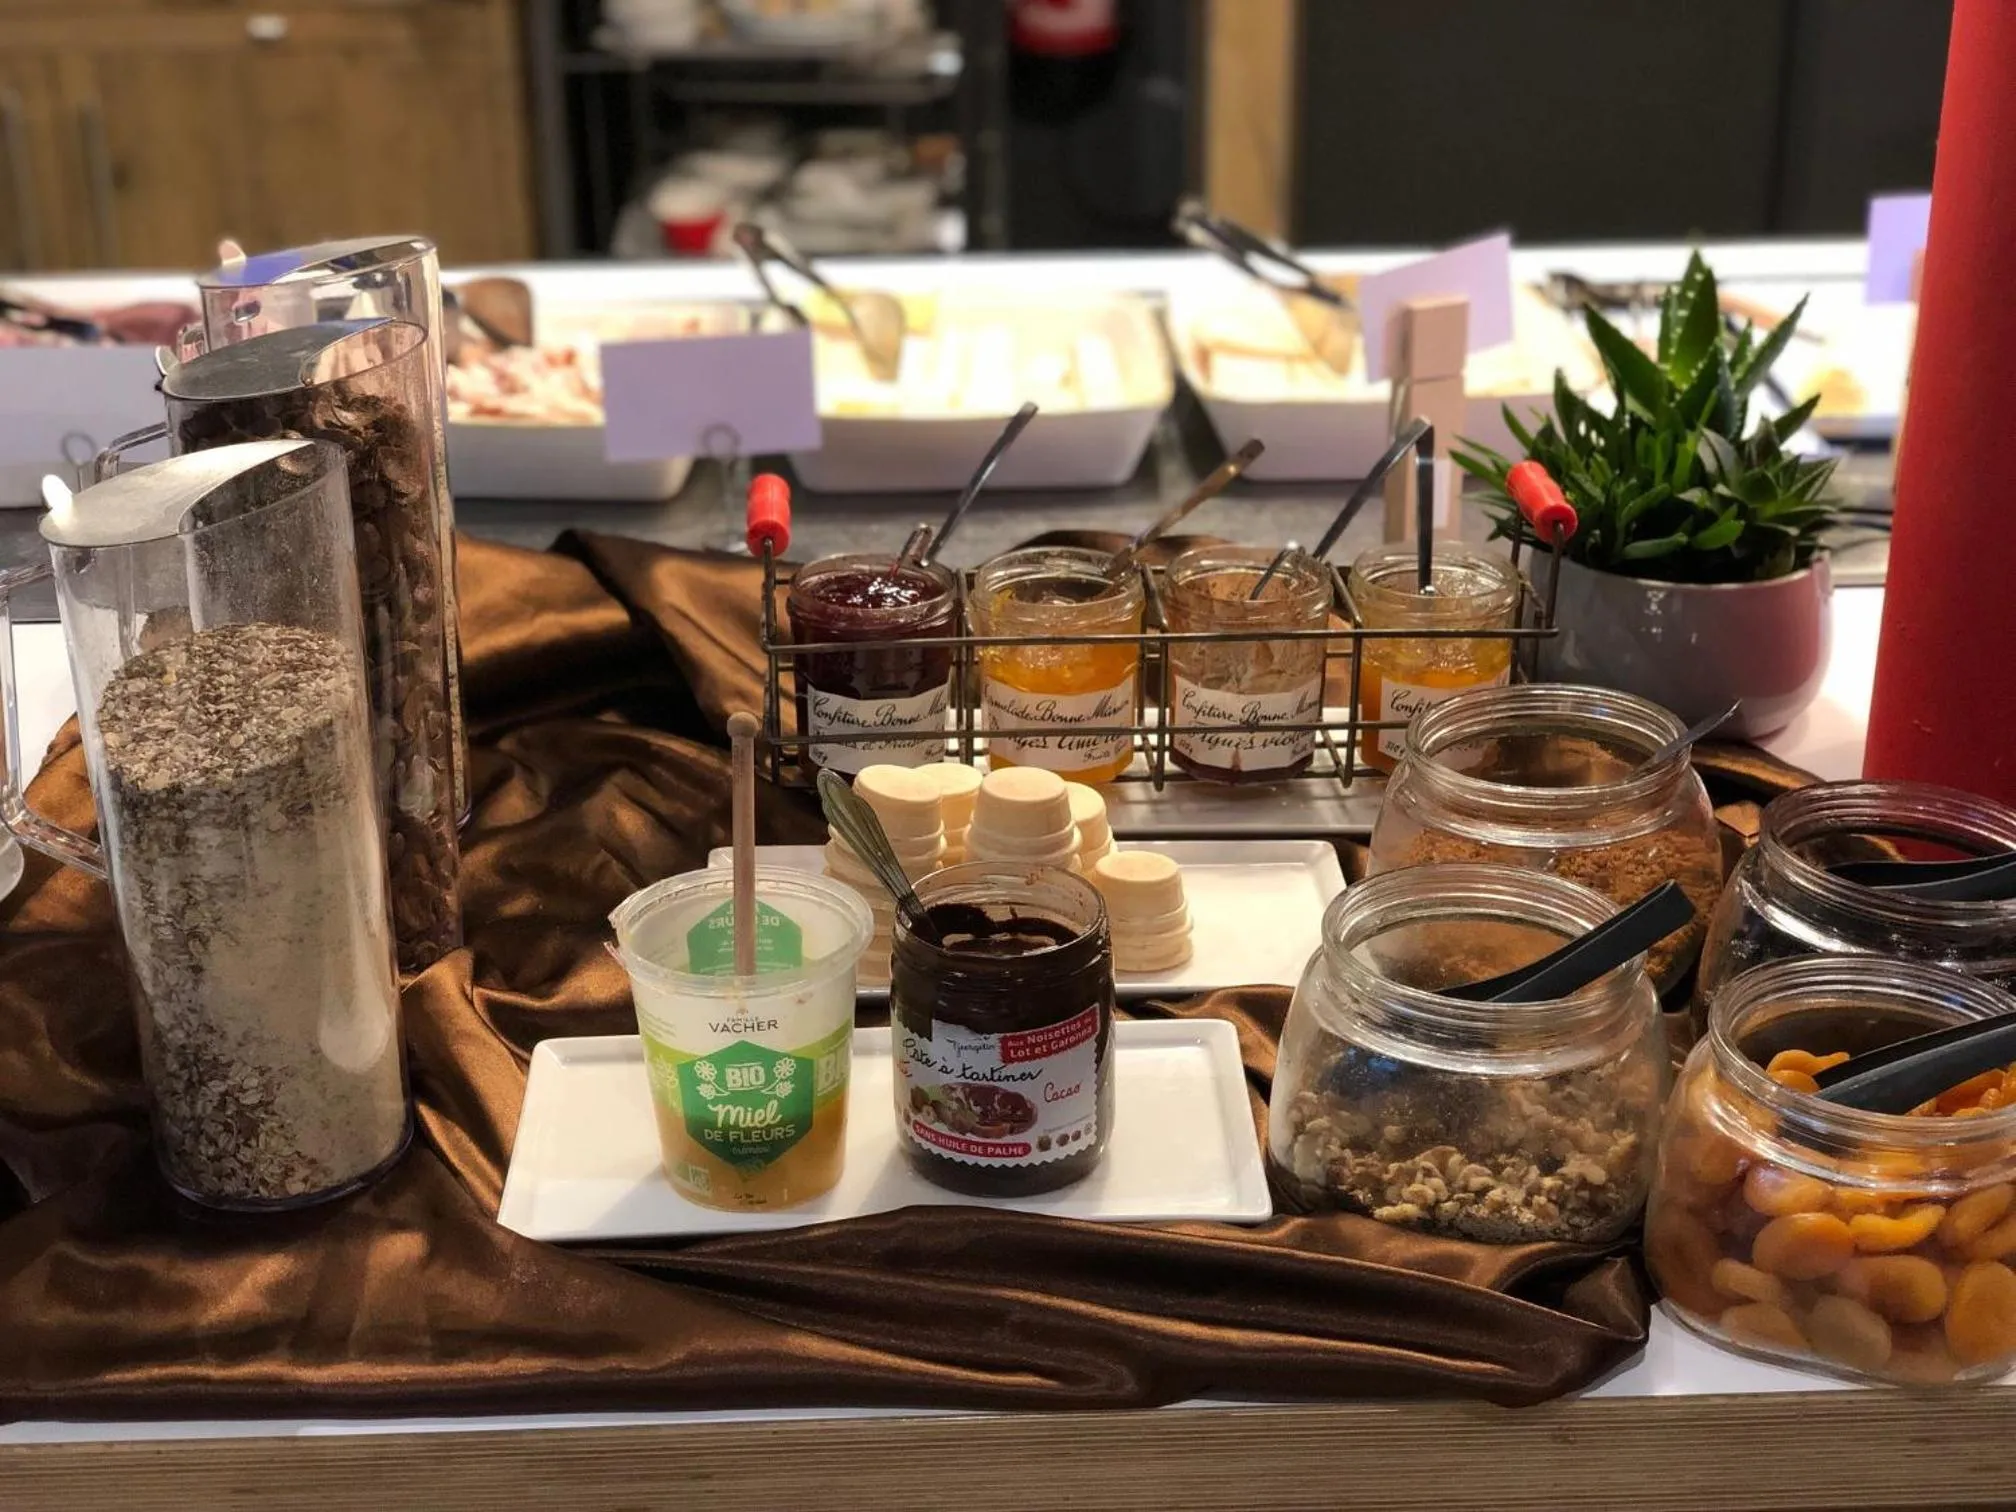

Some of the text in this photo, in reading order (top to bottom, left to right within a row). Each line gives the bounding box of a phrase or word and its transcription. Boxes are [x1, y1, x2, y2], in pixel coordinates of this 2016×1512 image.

[813, 697, 872, 728] Confiture
[873, 703, 921, 727] Bonne
[1034, 700, 1085, 723] Bonne
[1181, 688, 1237, 722] Confiture
[1238, 701, 1288, 726] Bonne
[708, 1019, 779, 1034] VACHER
[1026, 1021, 1082, 1045] Noisettes
[1009, 1025, 1093, 1059] Lot et Garonne
[725, 1063, 767, 1089] BIO
[937, 1055, 955, 1075] à
[956, 1062, 1044, 1083] tartiner
[1043, 1080, 1081, 1104] Cacao
[707, 1100, 783, 1128] Miel
[703, 1124, 796, 1143] DE FLEURS
[915, 1124, 1025, 1156] SANS HUILE DE PALME
